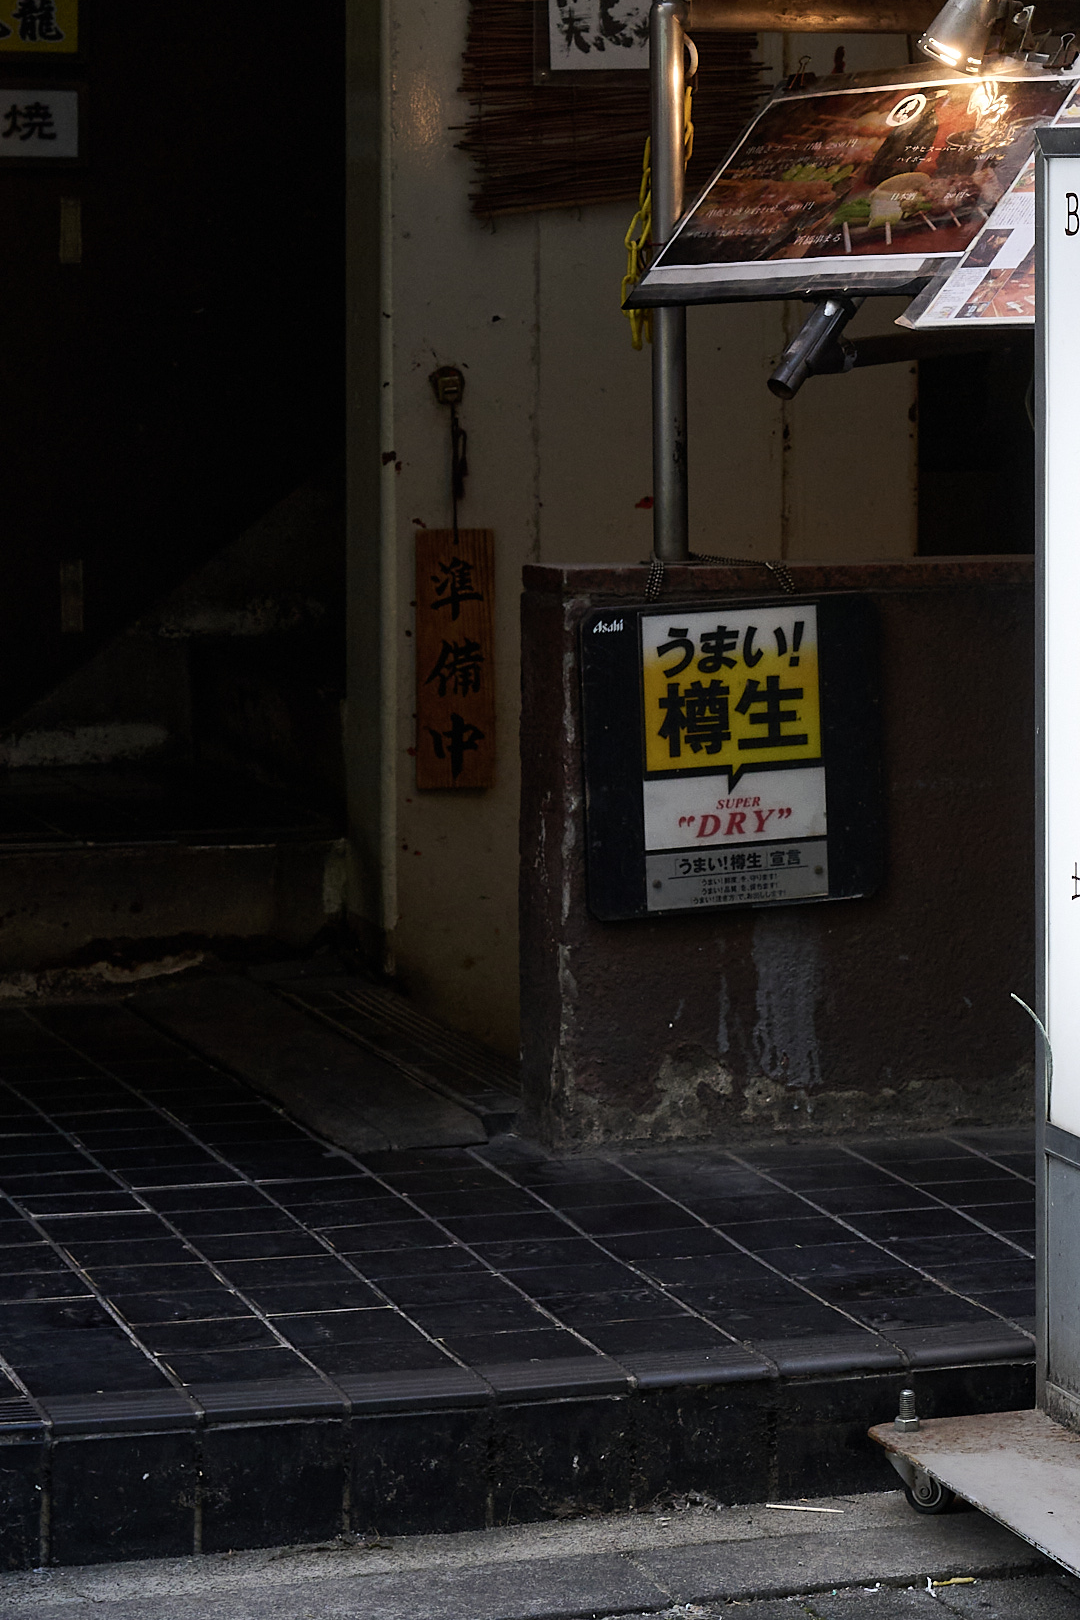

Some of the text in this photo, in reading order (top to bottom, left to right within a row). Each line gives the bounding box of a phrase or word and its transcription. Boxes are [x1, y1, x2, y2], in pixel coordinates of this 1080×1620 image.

[592, 618, 624, 635] Asahi
[656, 619, 805, 679] うまい!
[424, 556, 486, 780] 準備中
[657, 674, 809, 758] 樽生
[716, 796, 761, 810] SUPER
